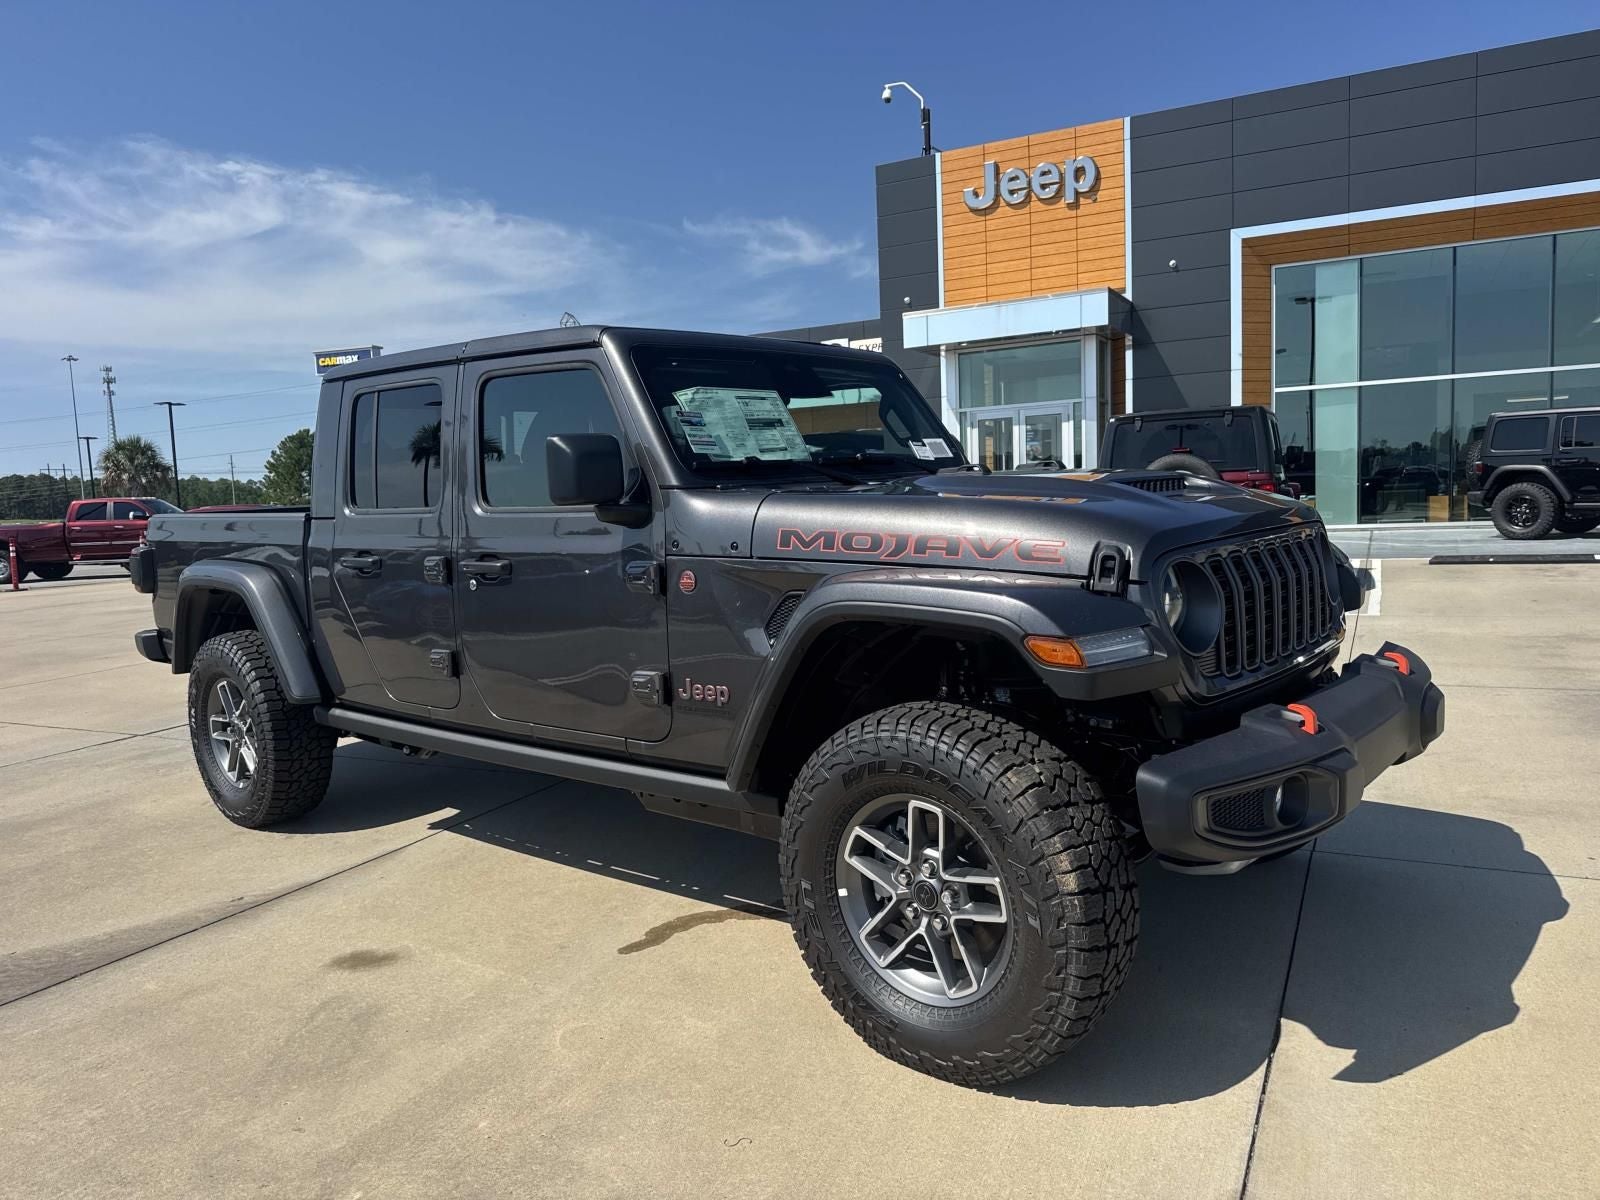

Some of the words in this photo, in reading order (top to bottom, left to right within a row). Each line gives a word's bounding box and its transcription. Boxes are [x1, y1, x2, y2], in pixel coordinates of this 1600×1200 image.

[963, 156, 1097, 209] Jeep
[777, 528, 1066, 564] MOJAVE
[678, 678, 730, 706] Jeep
